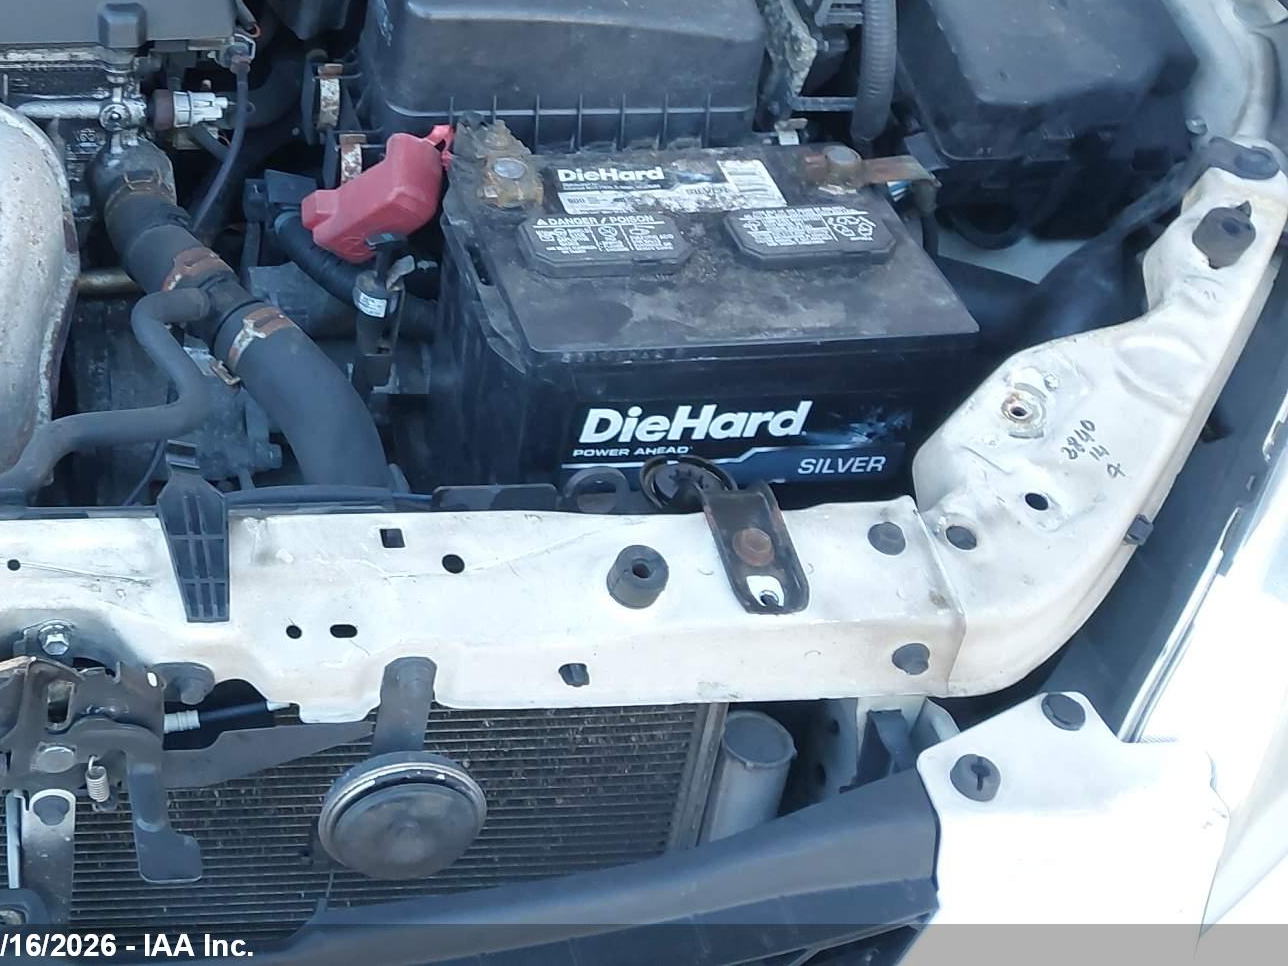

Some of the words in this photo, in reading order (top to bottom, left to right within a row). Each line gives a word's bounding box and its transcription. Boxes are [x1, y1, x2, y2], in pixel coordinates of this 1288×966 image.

[557, 166, 665, 183] DieHard
[548, 217, 598, 225] DANGER
[609, 215, 655, 224] POISON
[579, 401, 812, 443] DieHard
[573, 448, 629, 457] POWER
[634, 446, 690, 456] AHEAD
[797, 455, 886, 475] SILVER
